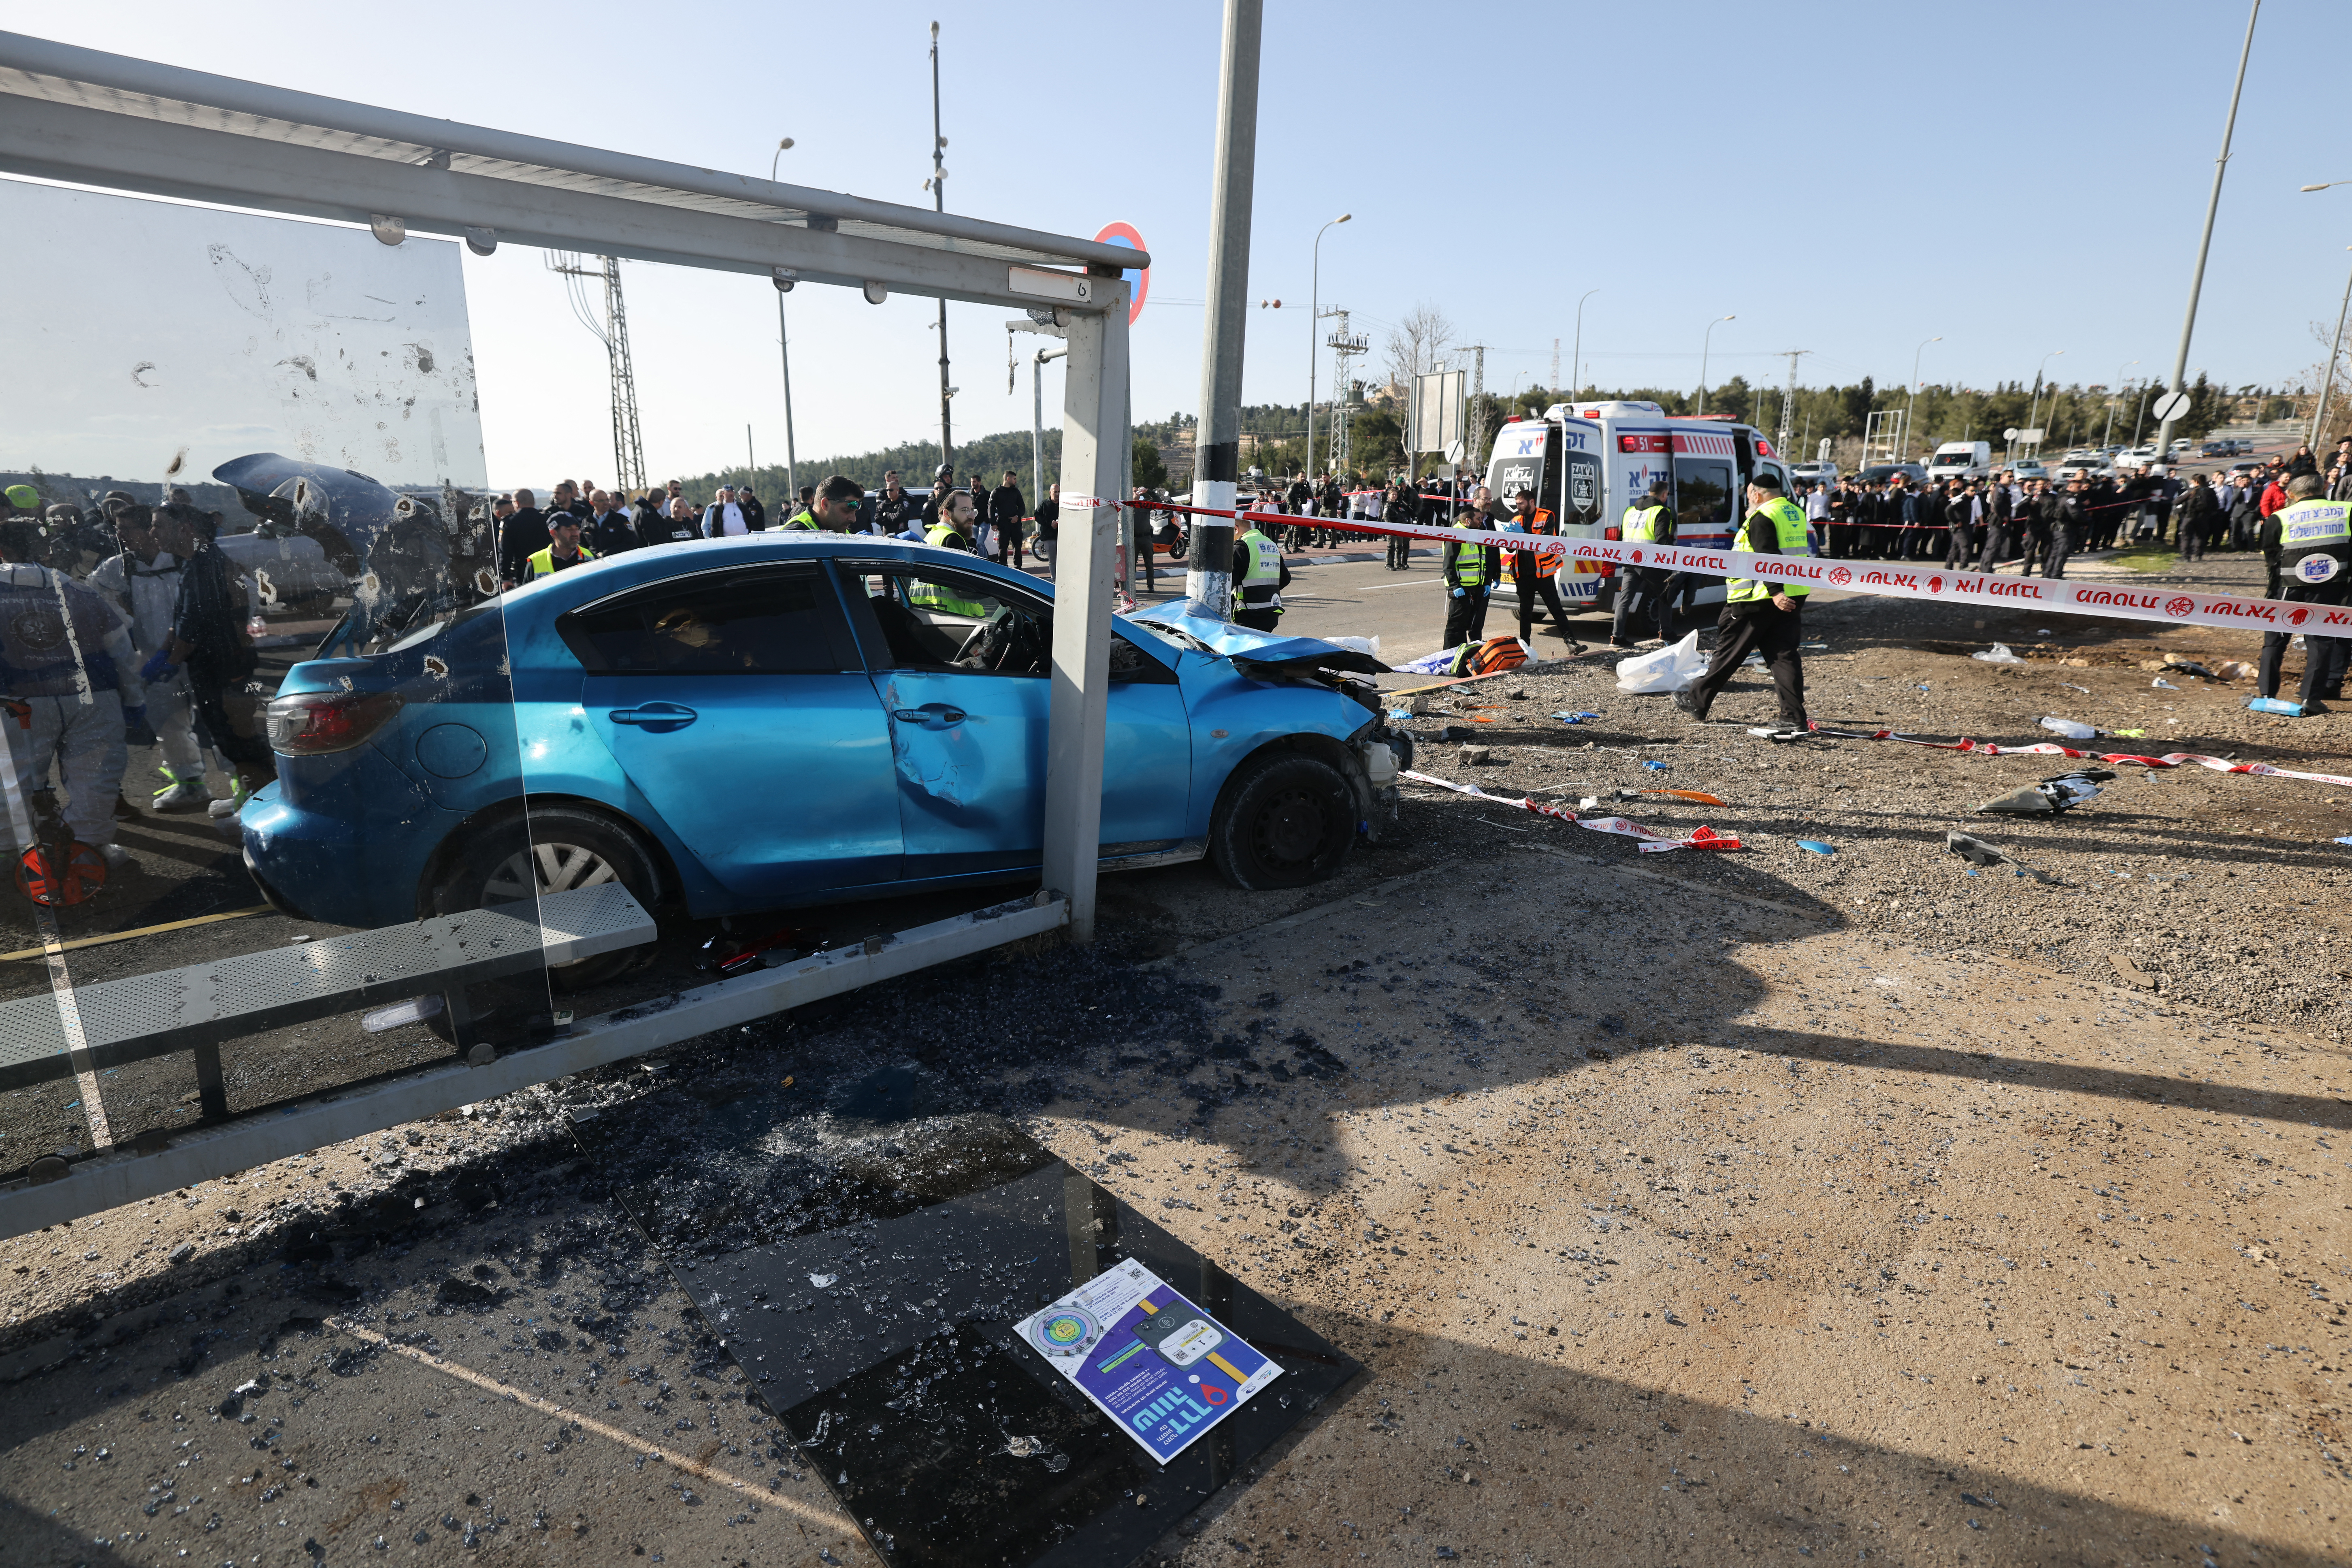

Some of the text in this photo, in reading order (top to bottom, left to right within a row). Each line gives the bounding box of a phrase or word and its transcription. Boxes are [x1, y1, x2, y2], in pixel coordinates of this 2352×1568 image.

[1639, 437, 1649, 451] 51
[2289, 507, 2344, 522] קמב"צ זק"א
[2290, 523, 2344, 538] מחוז ירושלים
[1573, 545, 1622, 561] ישראל
[1654, 551, 1677, 565] אין
[1682, 555, 1727, 570] מעבר
[1754, 561, 2043, 599] משטרת ישראל אין מעבר
[1588, 584, 1594, 594] 51
[2076, 589, 2352, 625] משטרת ישראל אי
[1074, 1289, 1089, 1299] להטענת
[1097, 1276, 1111, 1285] הרב-קו
[1094, 1292, 1107, 1301] הנסיעה
[1106, 1285, 1119, 1293] שלכם?
[1092, 1294, 1110, 1306] בטוחים/ות
[1124, 1291, 1141, 1302] ביישומון!
[1112, 1306, 1124, 1314] רב-קו,
[1104, 1371, 1145, 1400] במכשיר התיקוף באוטובוס
[1129, 1378, 1142, 1388] הנסיעה
[1144, 1374, 1155, 1383] מרחק
[1120, 1395, 1132, 1405] העלייה
[1145, 1377, 1159, 1387] תצטרכו
[1157, 1370, 1167, 1378] לתקף
[1120, 1399, 1141, 1414] משלמים/ות
[1144, 1388, 1156, 1396] מרחק
[1155, 1380, 1168, 1390] הנסיעה
[1132, 1386, 1189, 1432] שווה
[1161, 1394, 1214, 1435] דרך
[1156, 1428, 1174, 1442] ולנסוע
[1161, 1432, 1178, 1445] לתקף
